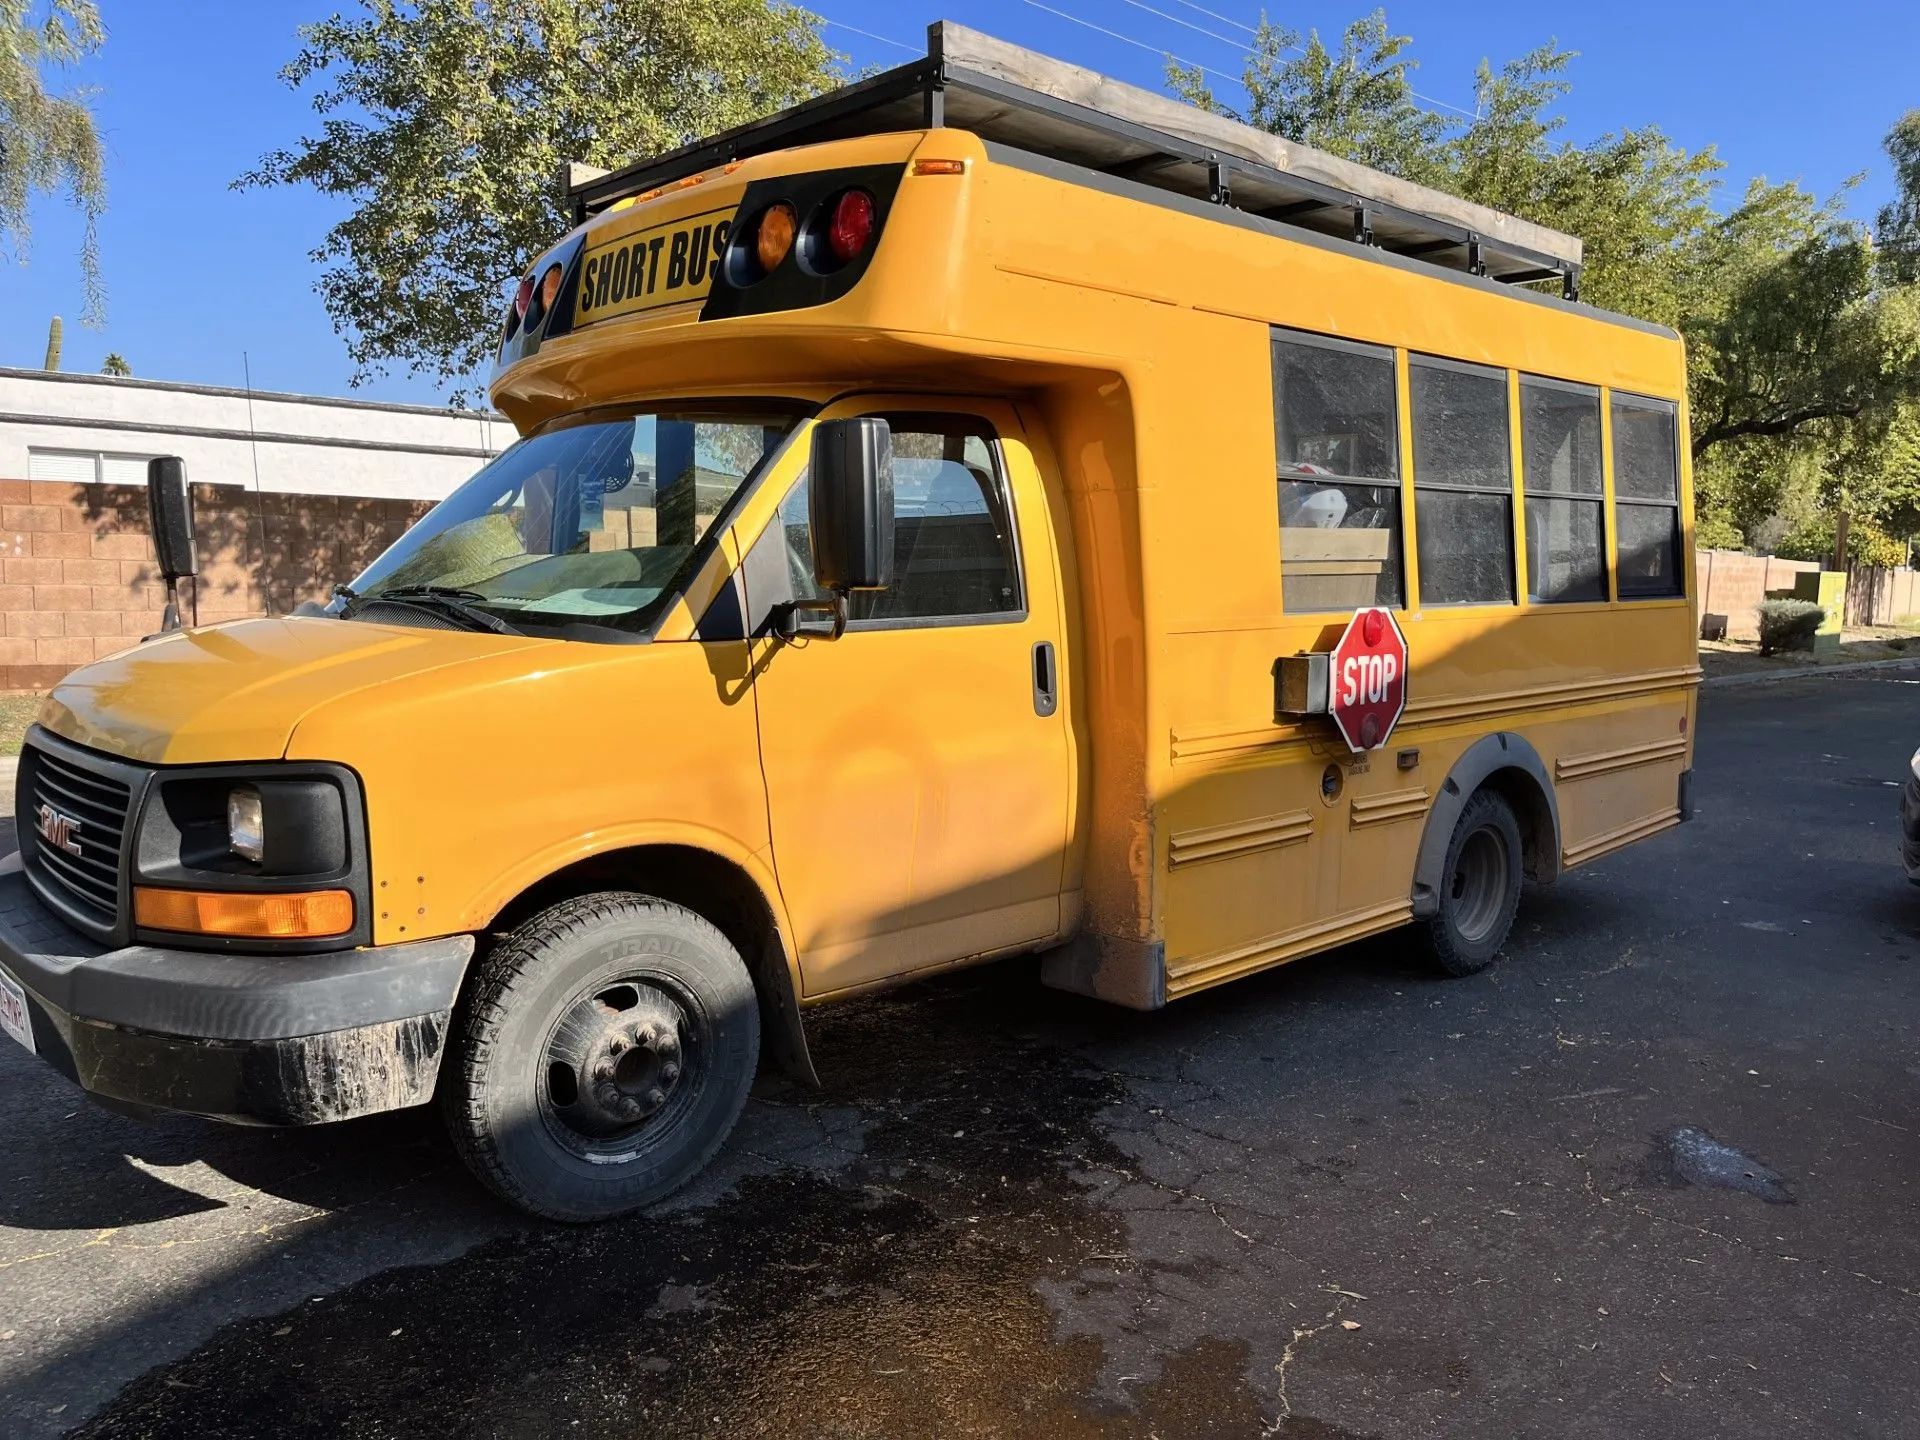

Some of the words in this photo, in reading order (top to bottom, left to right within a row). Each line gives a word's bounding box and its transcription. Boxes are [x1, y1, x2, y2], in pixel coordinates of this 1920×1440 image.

[581, 236, 666, 313] SHORT
[1343, 653, 1396, 706] STOP
[40, 804, 82, 856] GMC
